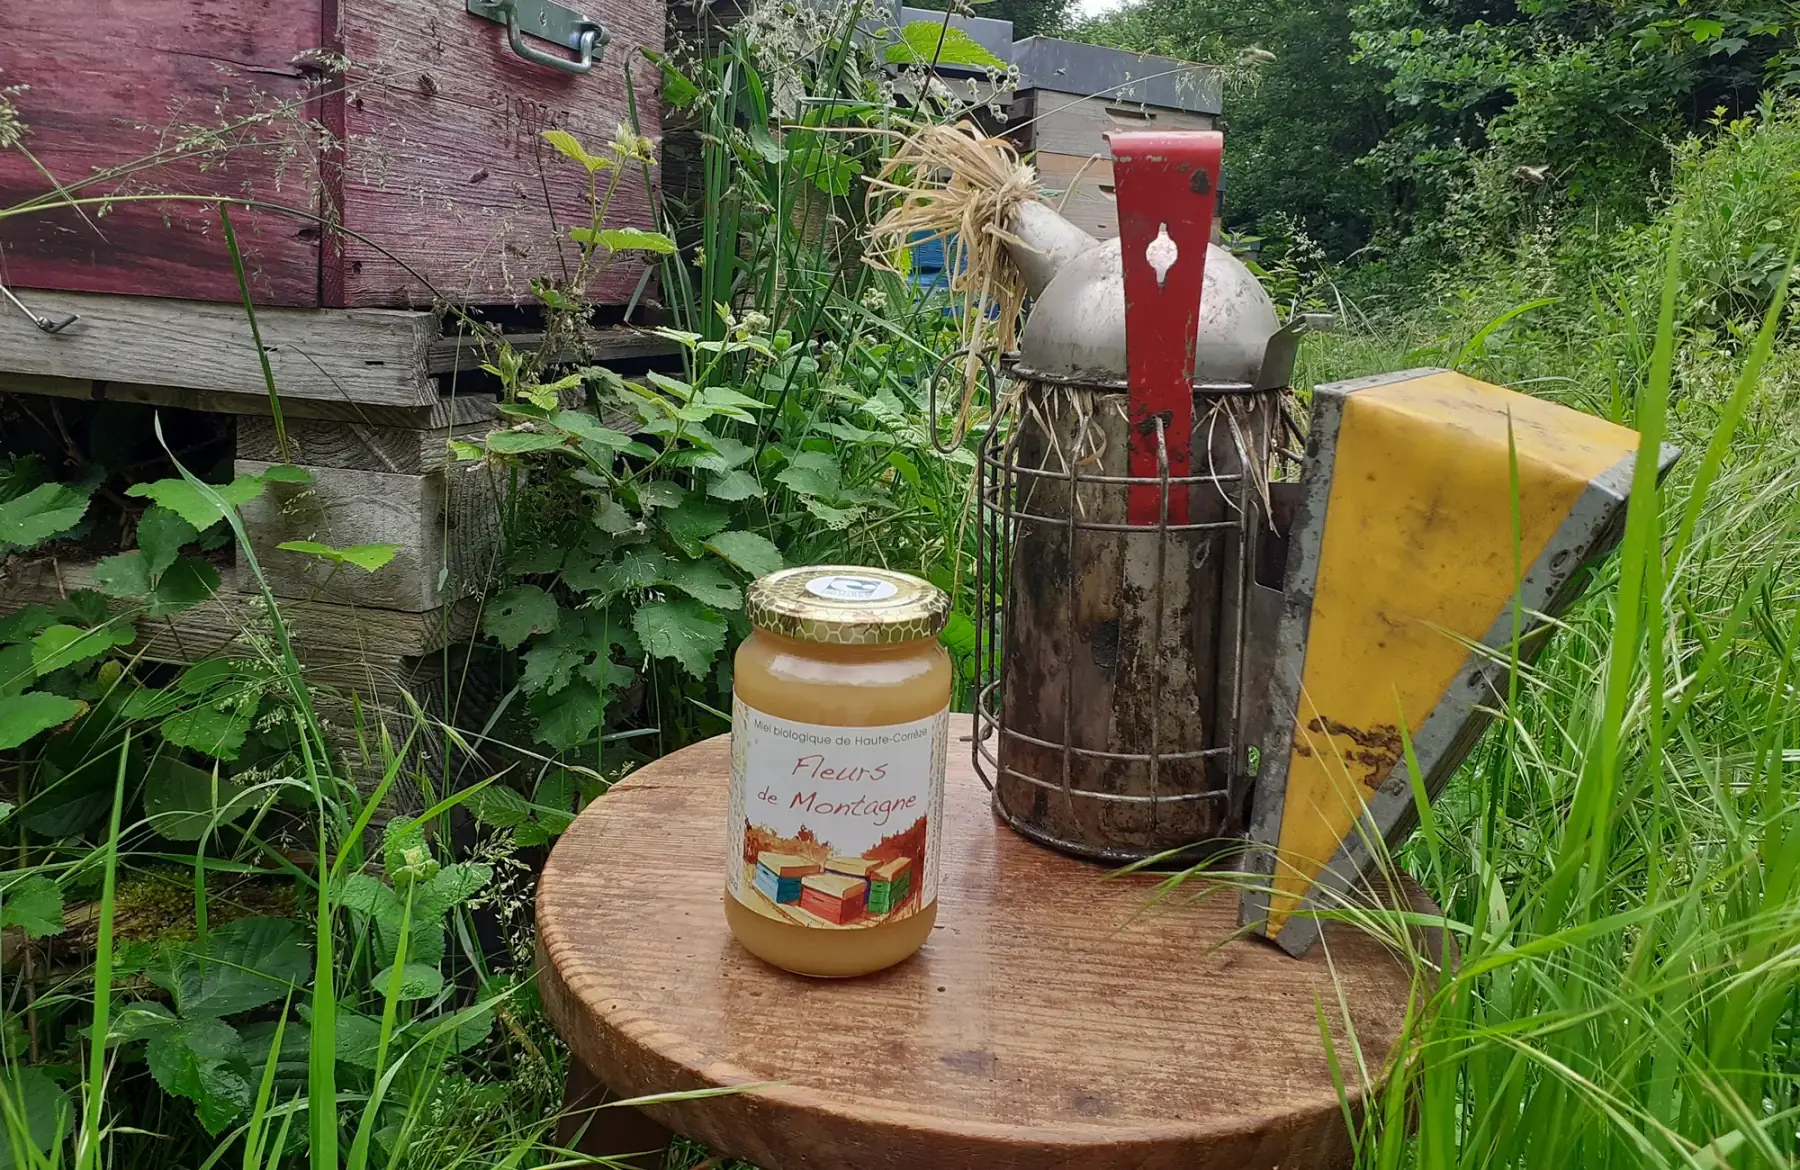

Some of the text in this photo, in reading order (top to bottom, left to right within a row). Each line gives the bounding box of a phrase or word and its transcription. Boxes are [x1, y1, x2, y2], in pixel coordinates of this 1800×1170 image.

[754, 718, 928, 746] Miel biologique de Haute-Corrèze
[791, 754, 889, 782] Fleurs
[757, 786, 917, 826] de Montagne
